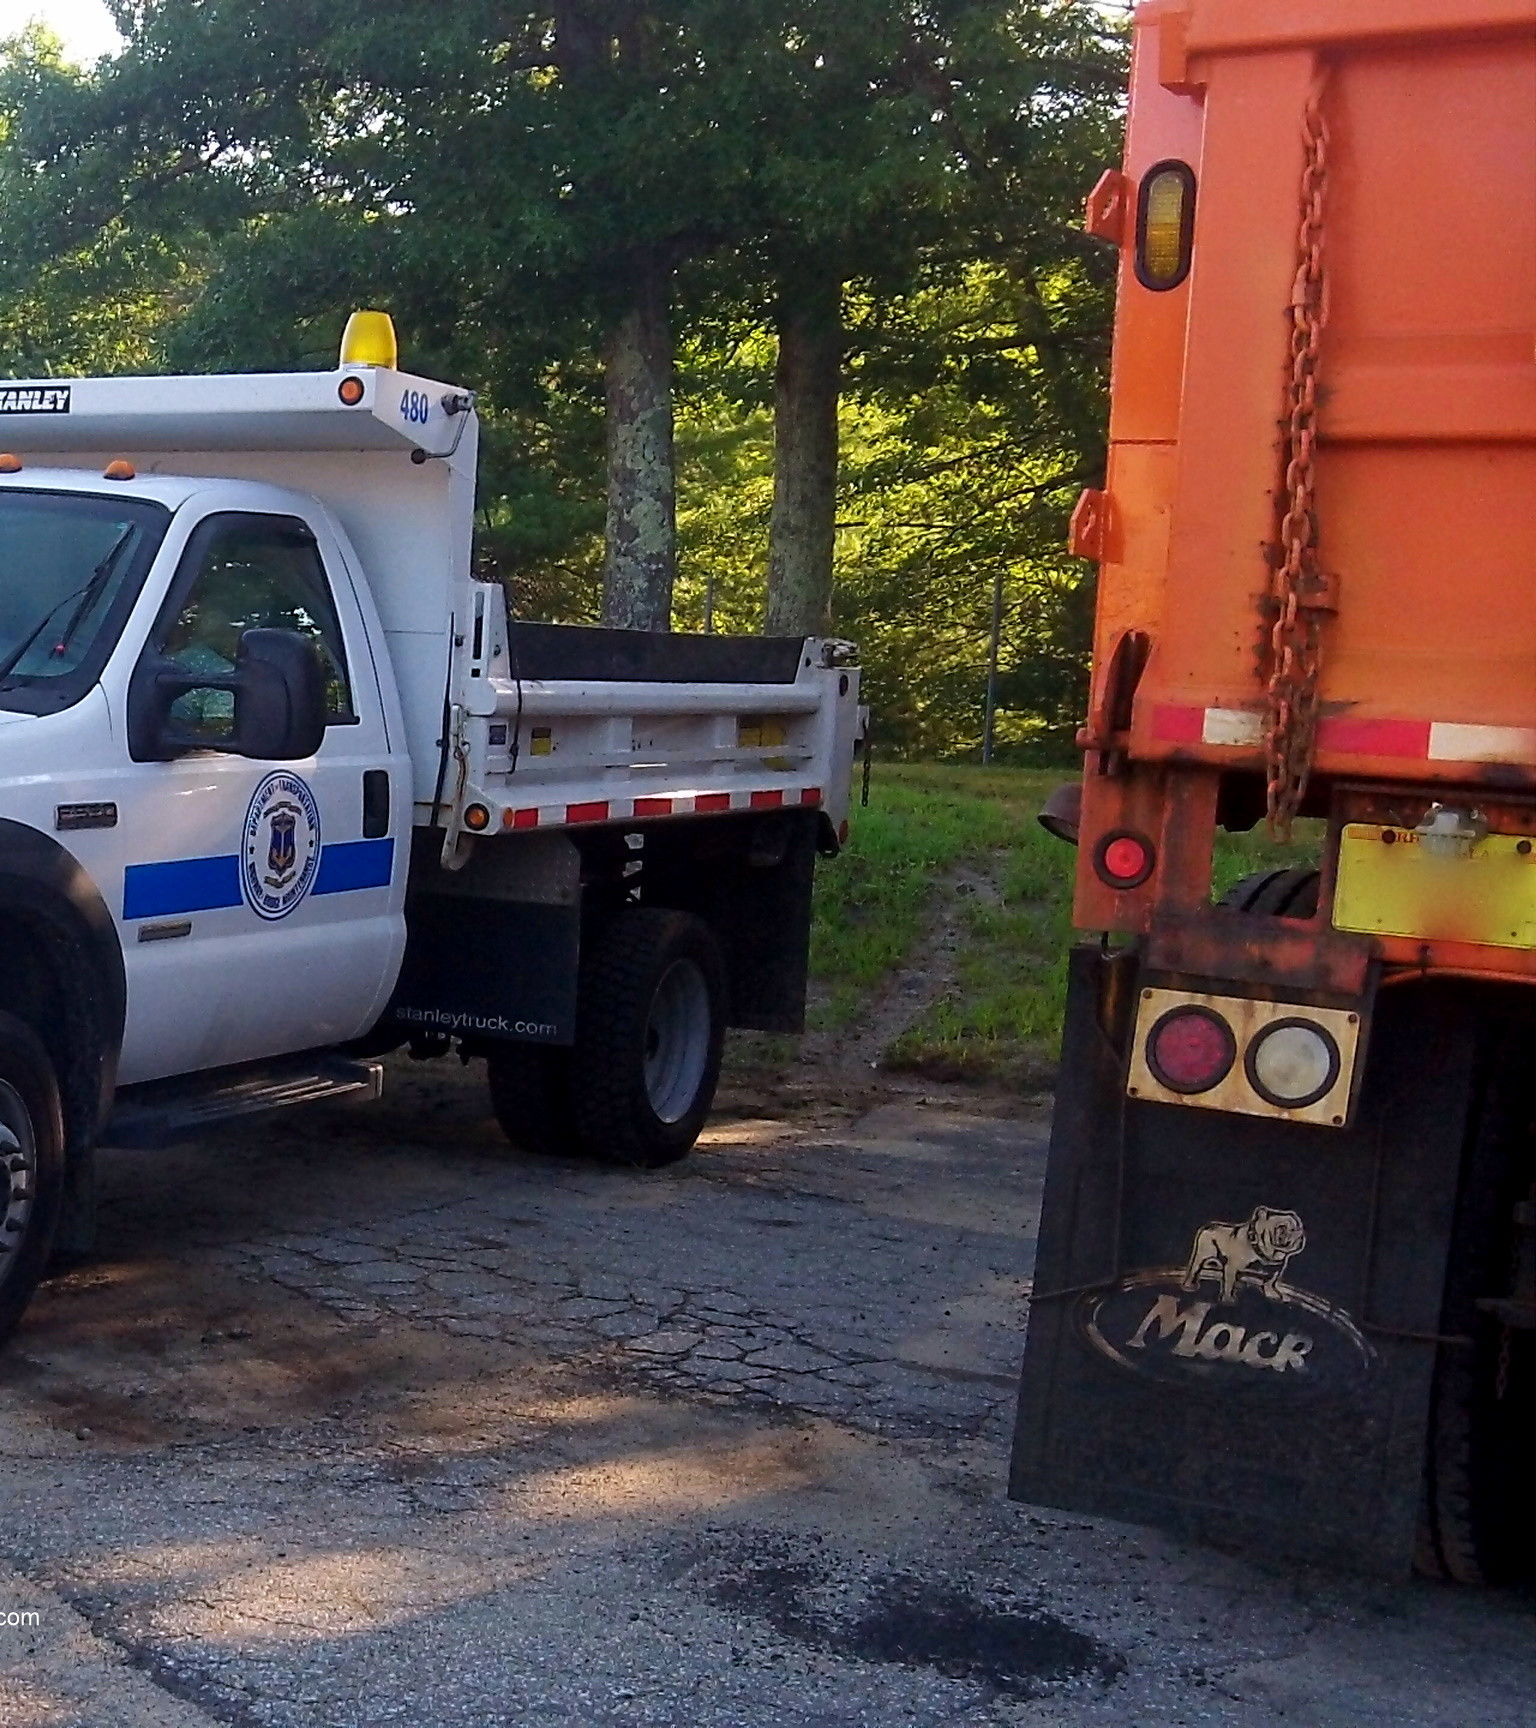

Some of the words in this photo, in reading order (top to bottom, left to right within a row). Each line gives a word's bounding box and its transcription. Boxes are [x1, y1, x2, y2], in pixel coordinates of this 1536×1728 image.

[400, 389, 428, 425] 480
[396, 1006, 558, 1036] stanleytruck.com
[1125, 1294, 1314, 1373] Mack
